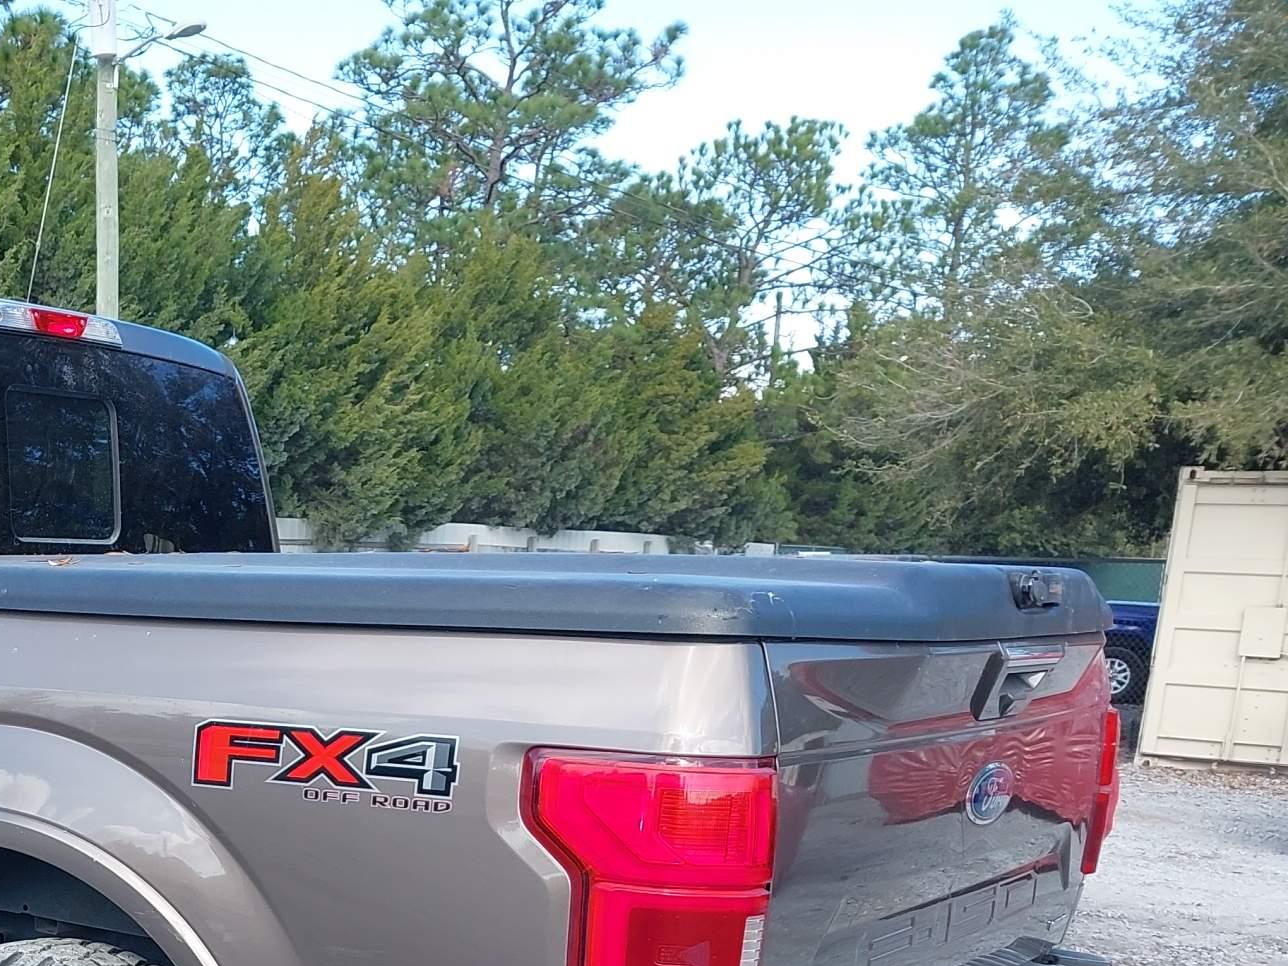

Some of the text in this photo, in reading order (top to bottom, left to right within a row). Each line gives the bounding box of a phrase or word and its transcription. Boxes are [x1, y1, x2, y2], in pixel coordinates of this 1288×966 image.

[192, 718, 460, 799] FX4
[302, 787, 452, 814] OFF ROAD
